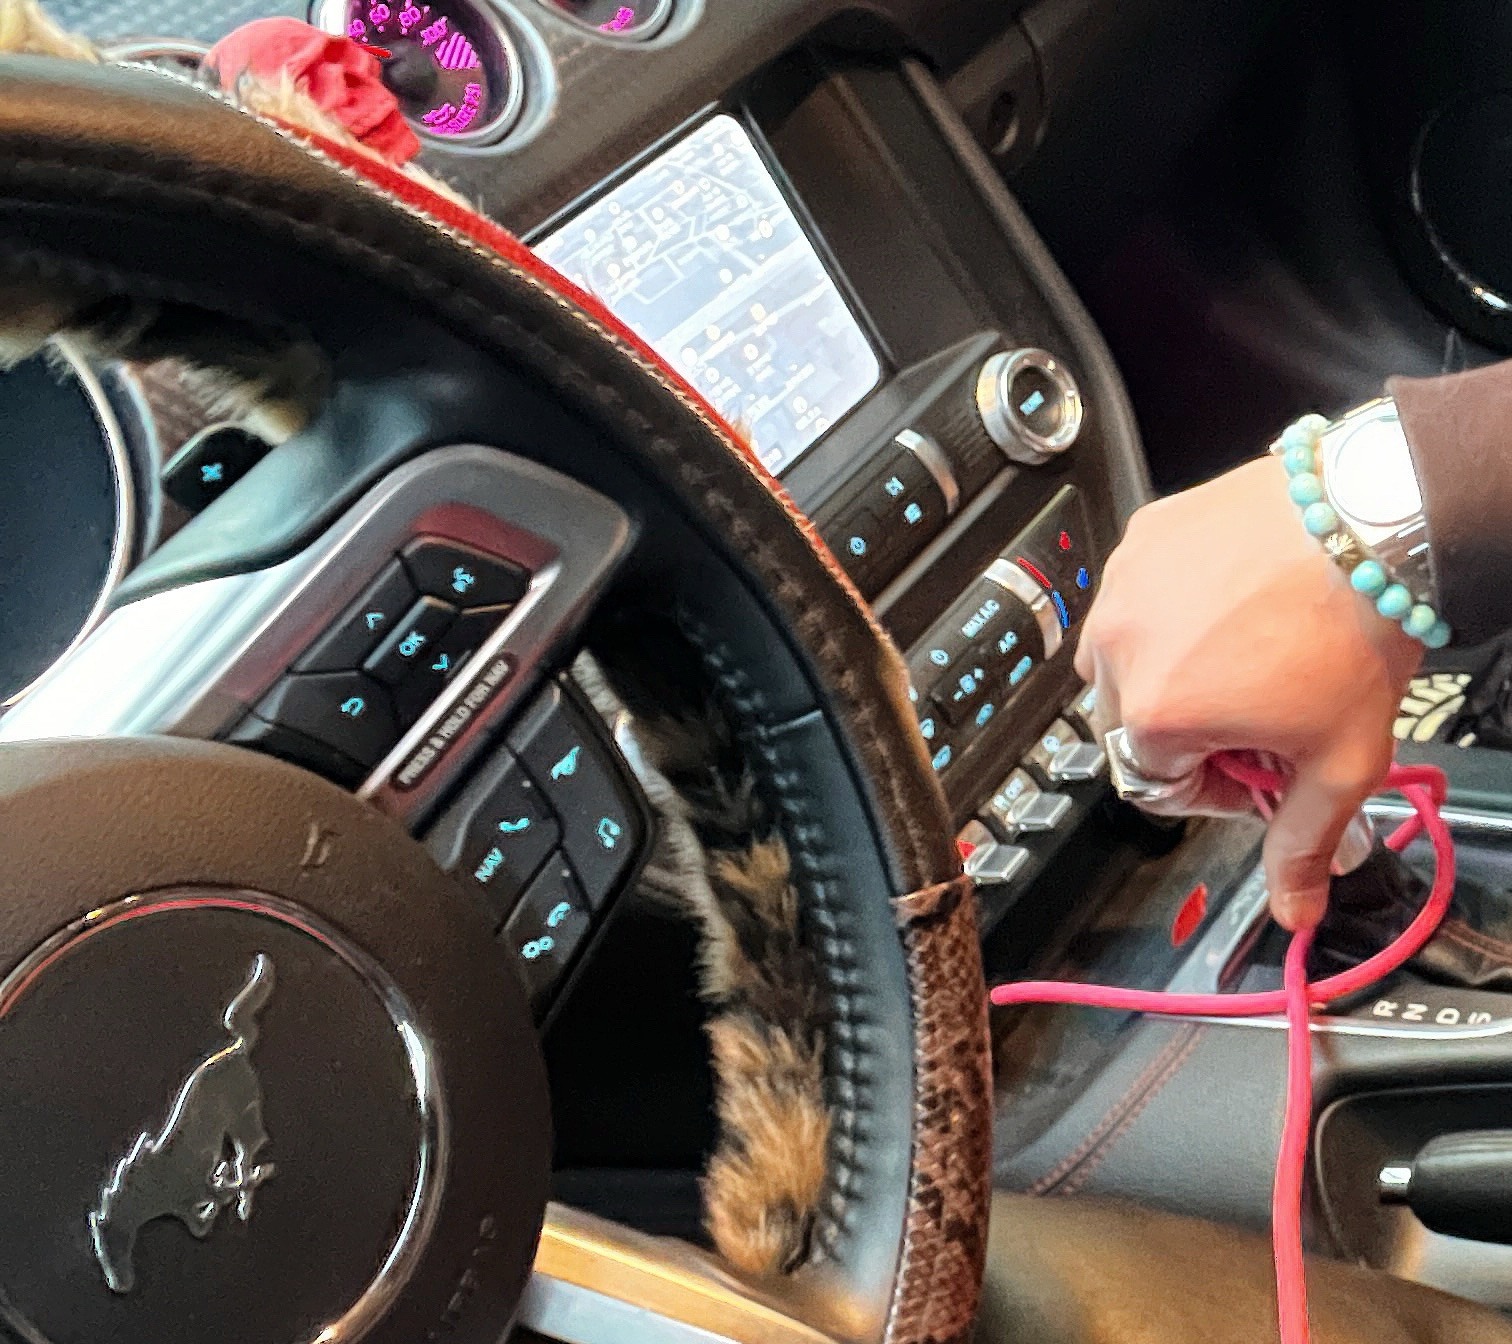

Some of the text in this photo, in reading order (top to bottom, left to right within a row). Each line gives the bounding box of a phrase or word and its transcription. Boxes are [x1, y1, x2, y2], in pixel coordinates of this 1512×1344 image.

[399, 631, 426, 657] OK
[474, 846, 503, 884] NAV
[1372, 999, 1399, 1017] R
